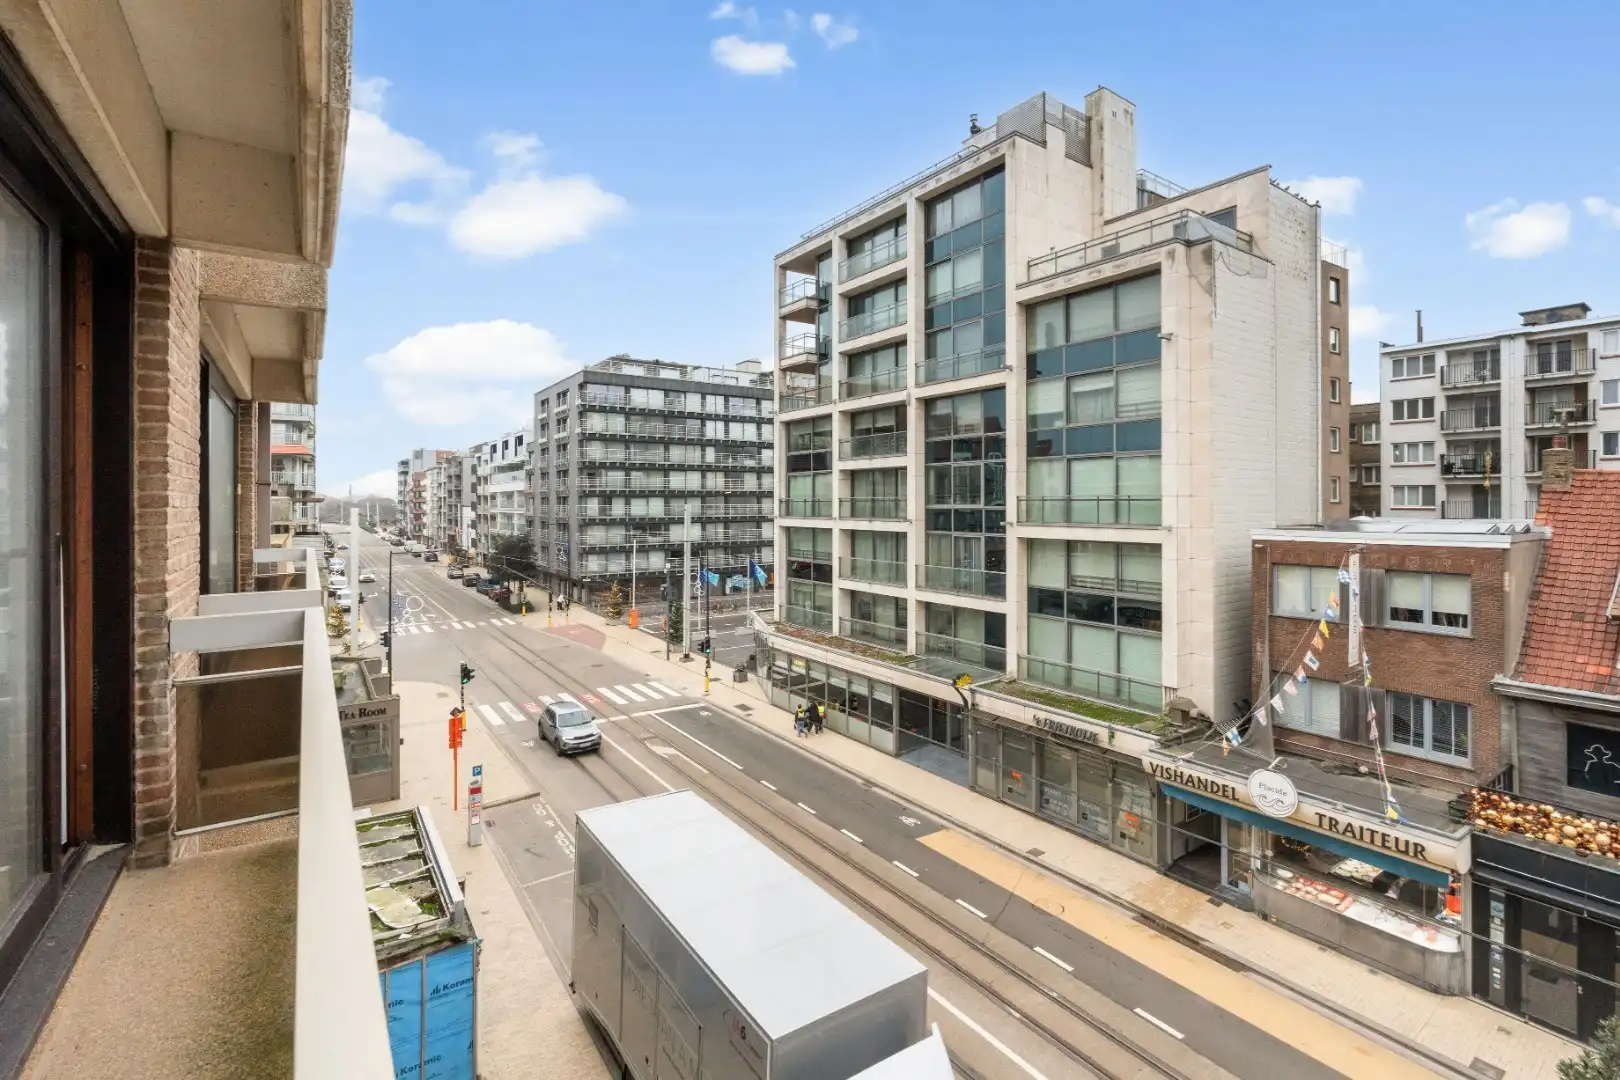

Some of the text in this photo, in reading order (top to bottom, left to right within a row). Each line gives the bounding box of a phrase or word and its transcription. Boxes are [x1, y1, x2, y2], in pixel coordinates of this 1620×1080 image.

[358, 707, 387, 718] ROOM
[1149, 761, 1240, 802] VISHANDEL
[1258, 781, 1288, 797] Placide
[1315, 812, 1428, 861] TRAITEUR
